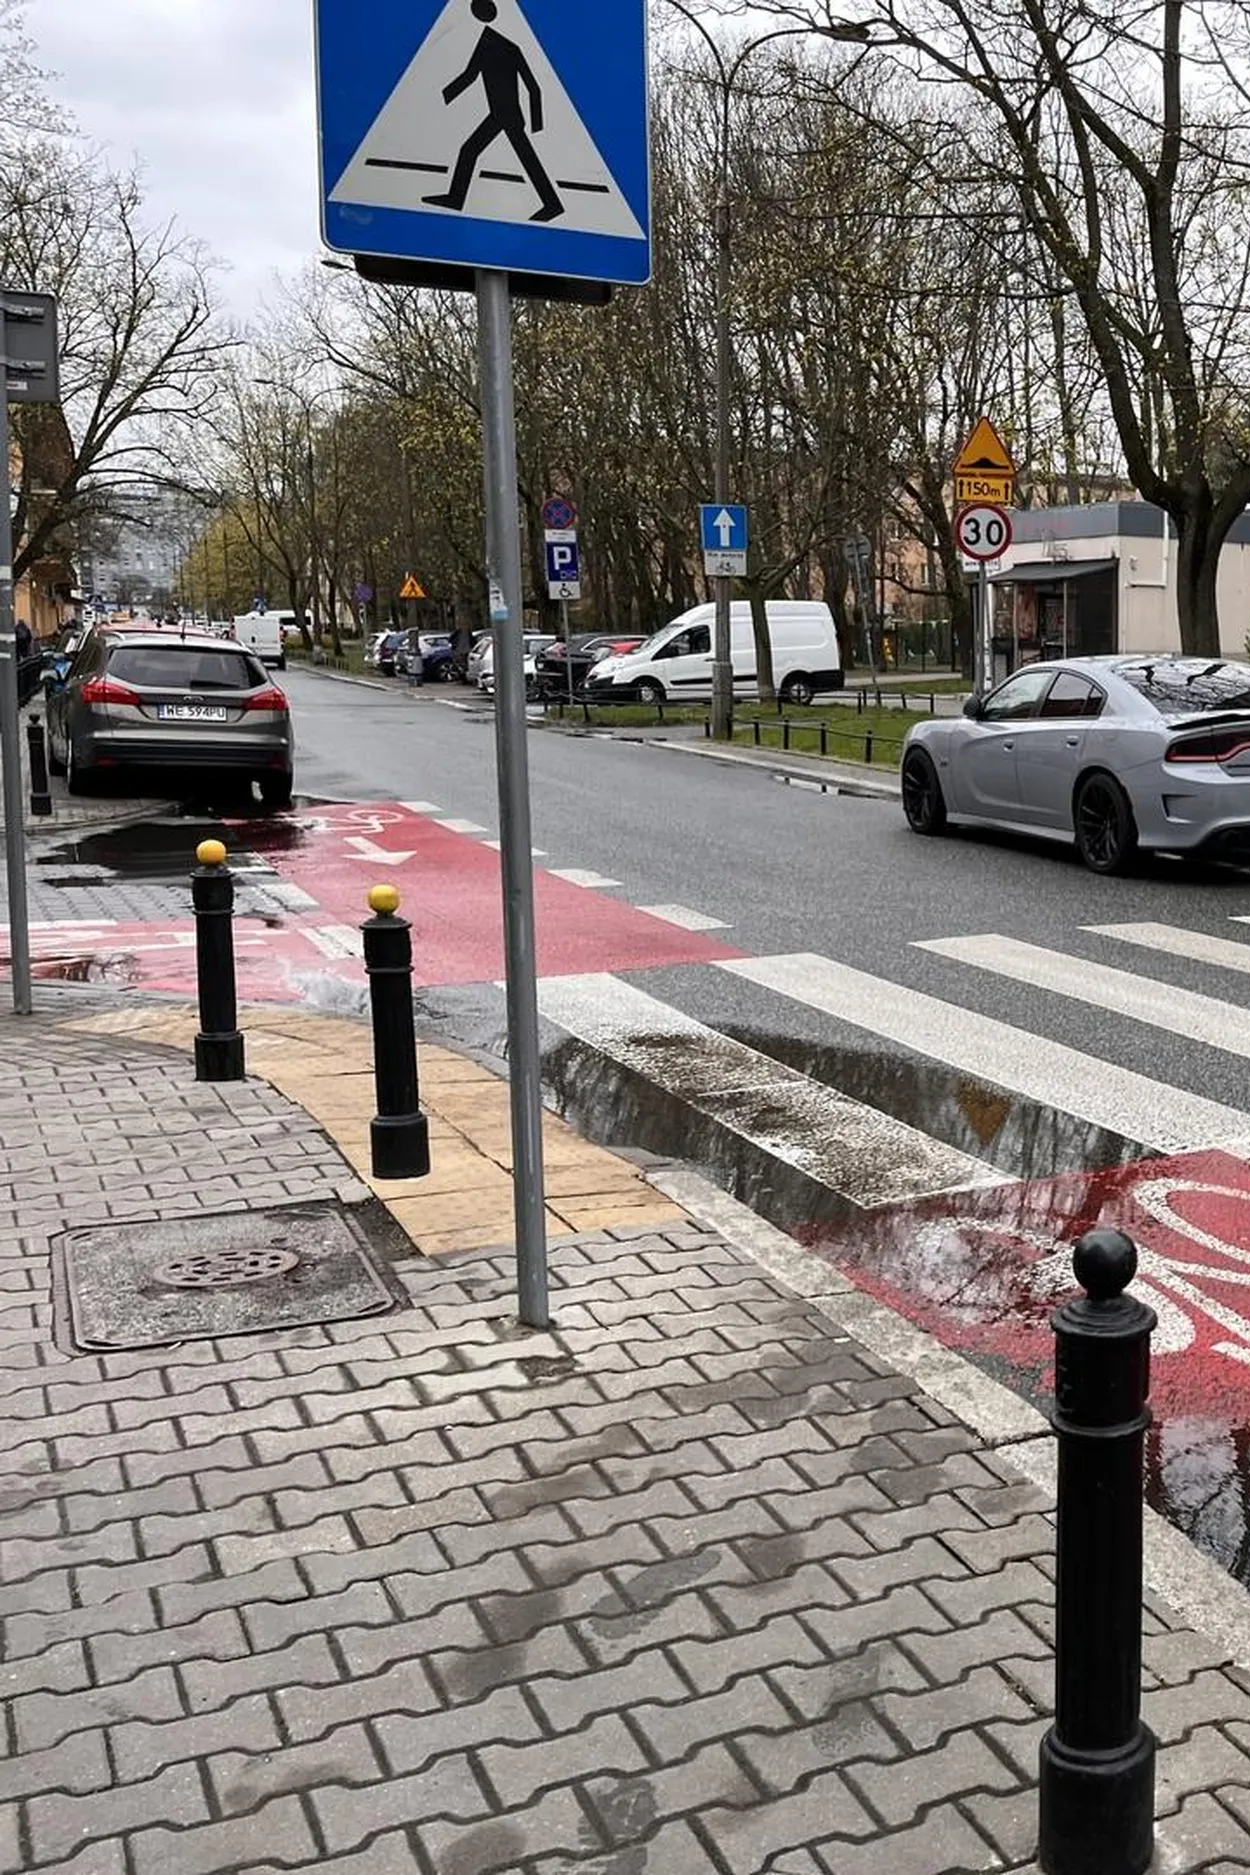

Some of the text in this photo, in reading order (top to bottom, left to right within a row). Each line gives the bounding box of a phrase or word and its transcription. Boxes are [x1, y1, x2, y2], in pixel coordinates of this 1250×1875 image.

[963, 517, 1004, 546] 30
[553, 546, 572, 570] P
[166, 704, 183, 717] WE
